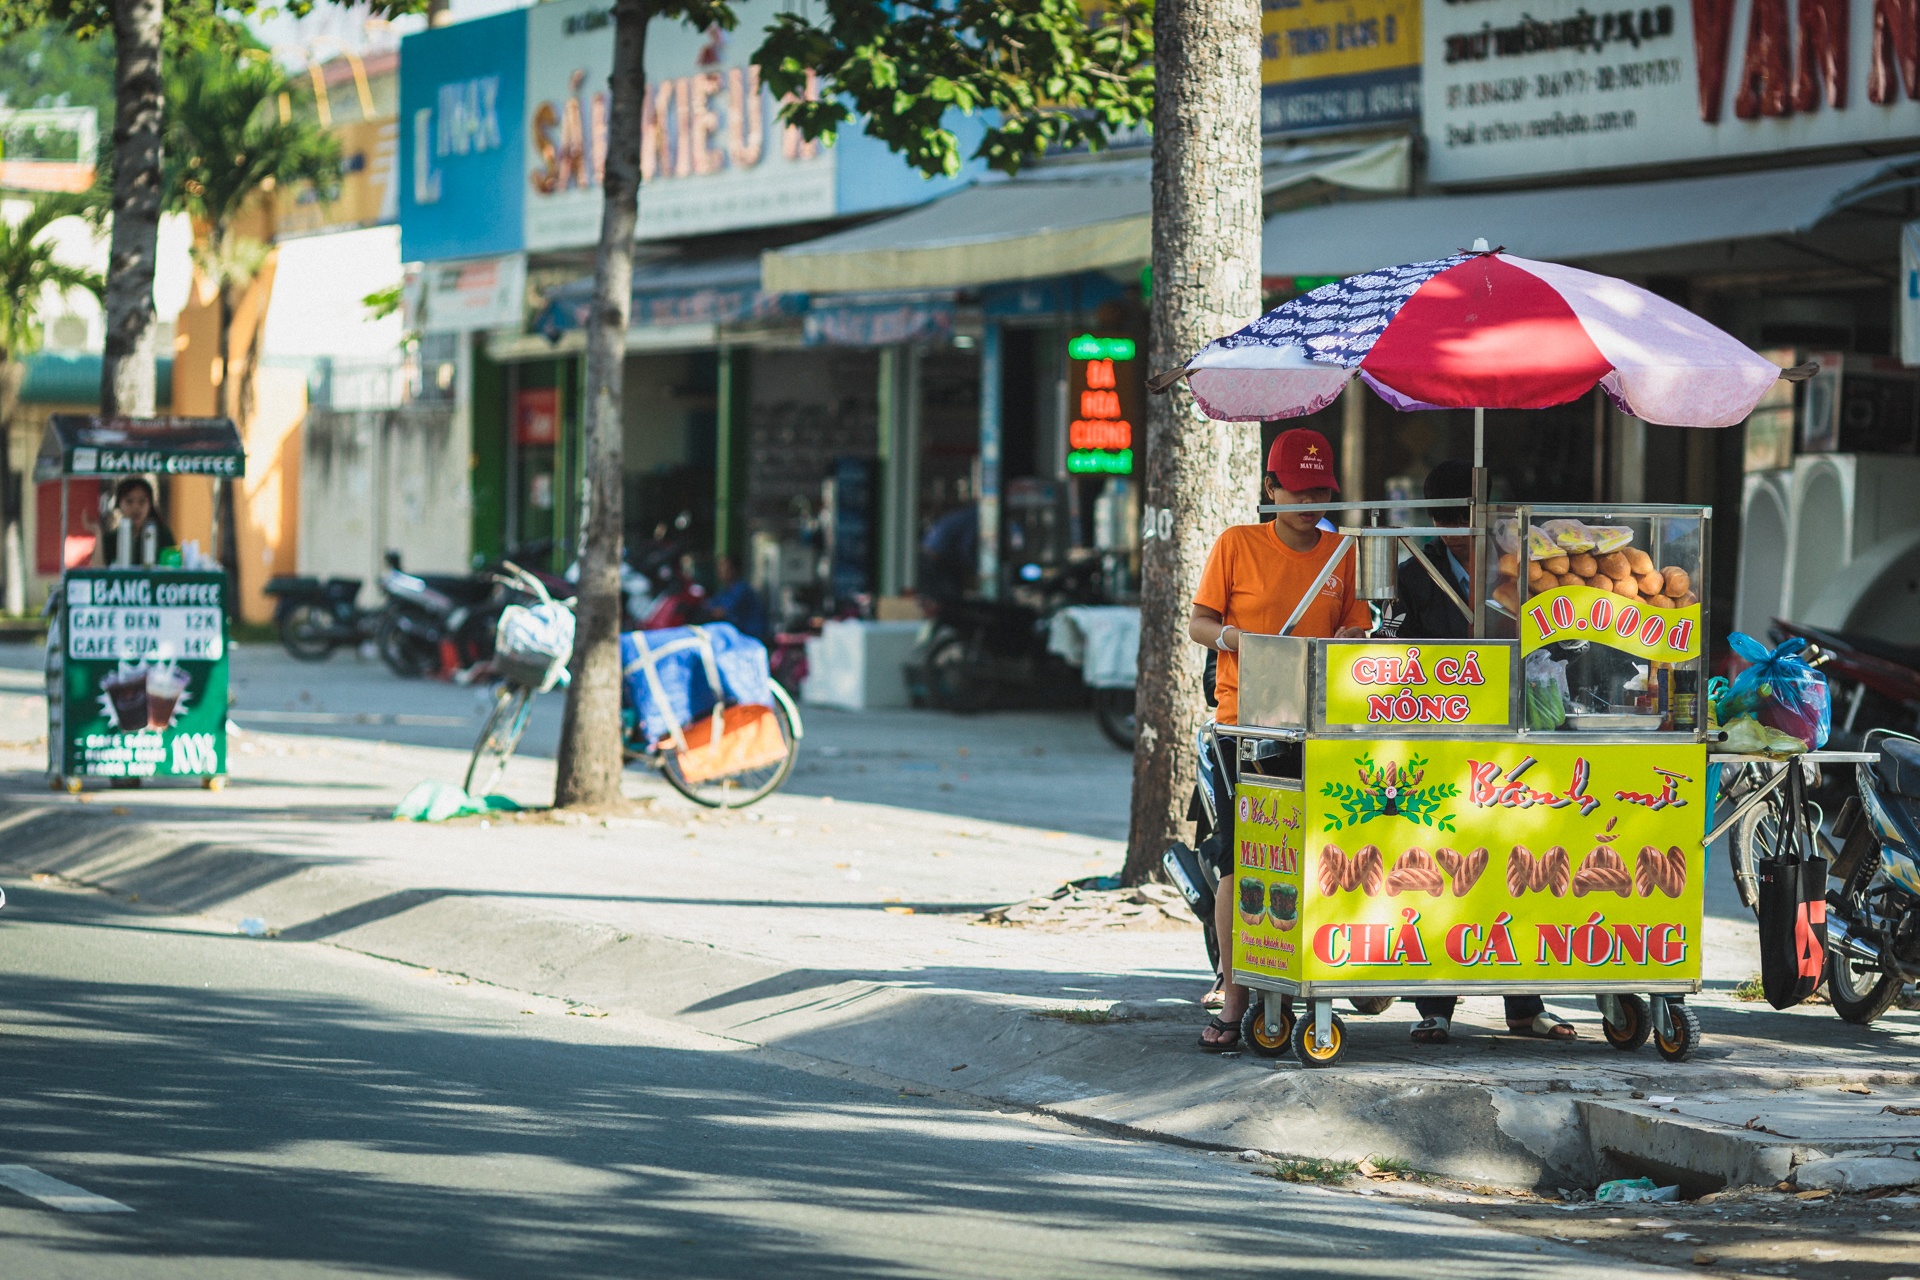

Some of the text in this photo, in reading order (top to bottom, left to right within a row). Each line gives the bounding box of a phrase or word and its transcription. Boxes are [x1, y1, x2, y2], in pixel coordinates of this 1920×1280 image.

[100, 450, 237, 475] BANG COFFEE
[93, 579, 221, 605] BANG COFFEE
[186, 612, 215, 629] 12K
[1528, 595, 1694, 652] 10.000đ
[1352, 647, 1485, 685] CHẢ CÁ
[1367, 688, 1470, 722] NÓNG
[1467, 755, 1693, 817] Bánh mì
[1251, 796, 1279, 831] Bánh
[1240, 833, 1299, 876] MAY MẮN
[1318, 816, 1686, 898] MAY MẮN
[1313, 907, 1689, 967] CHẢ CÁ NÓNG
